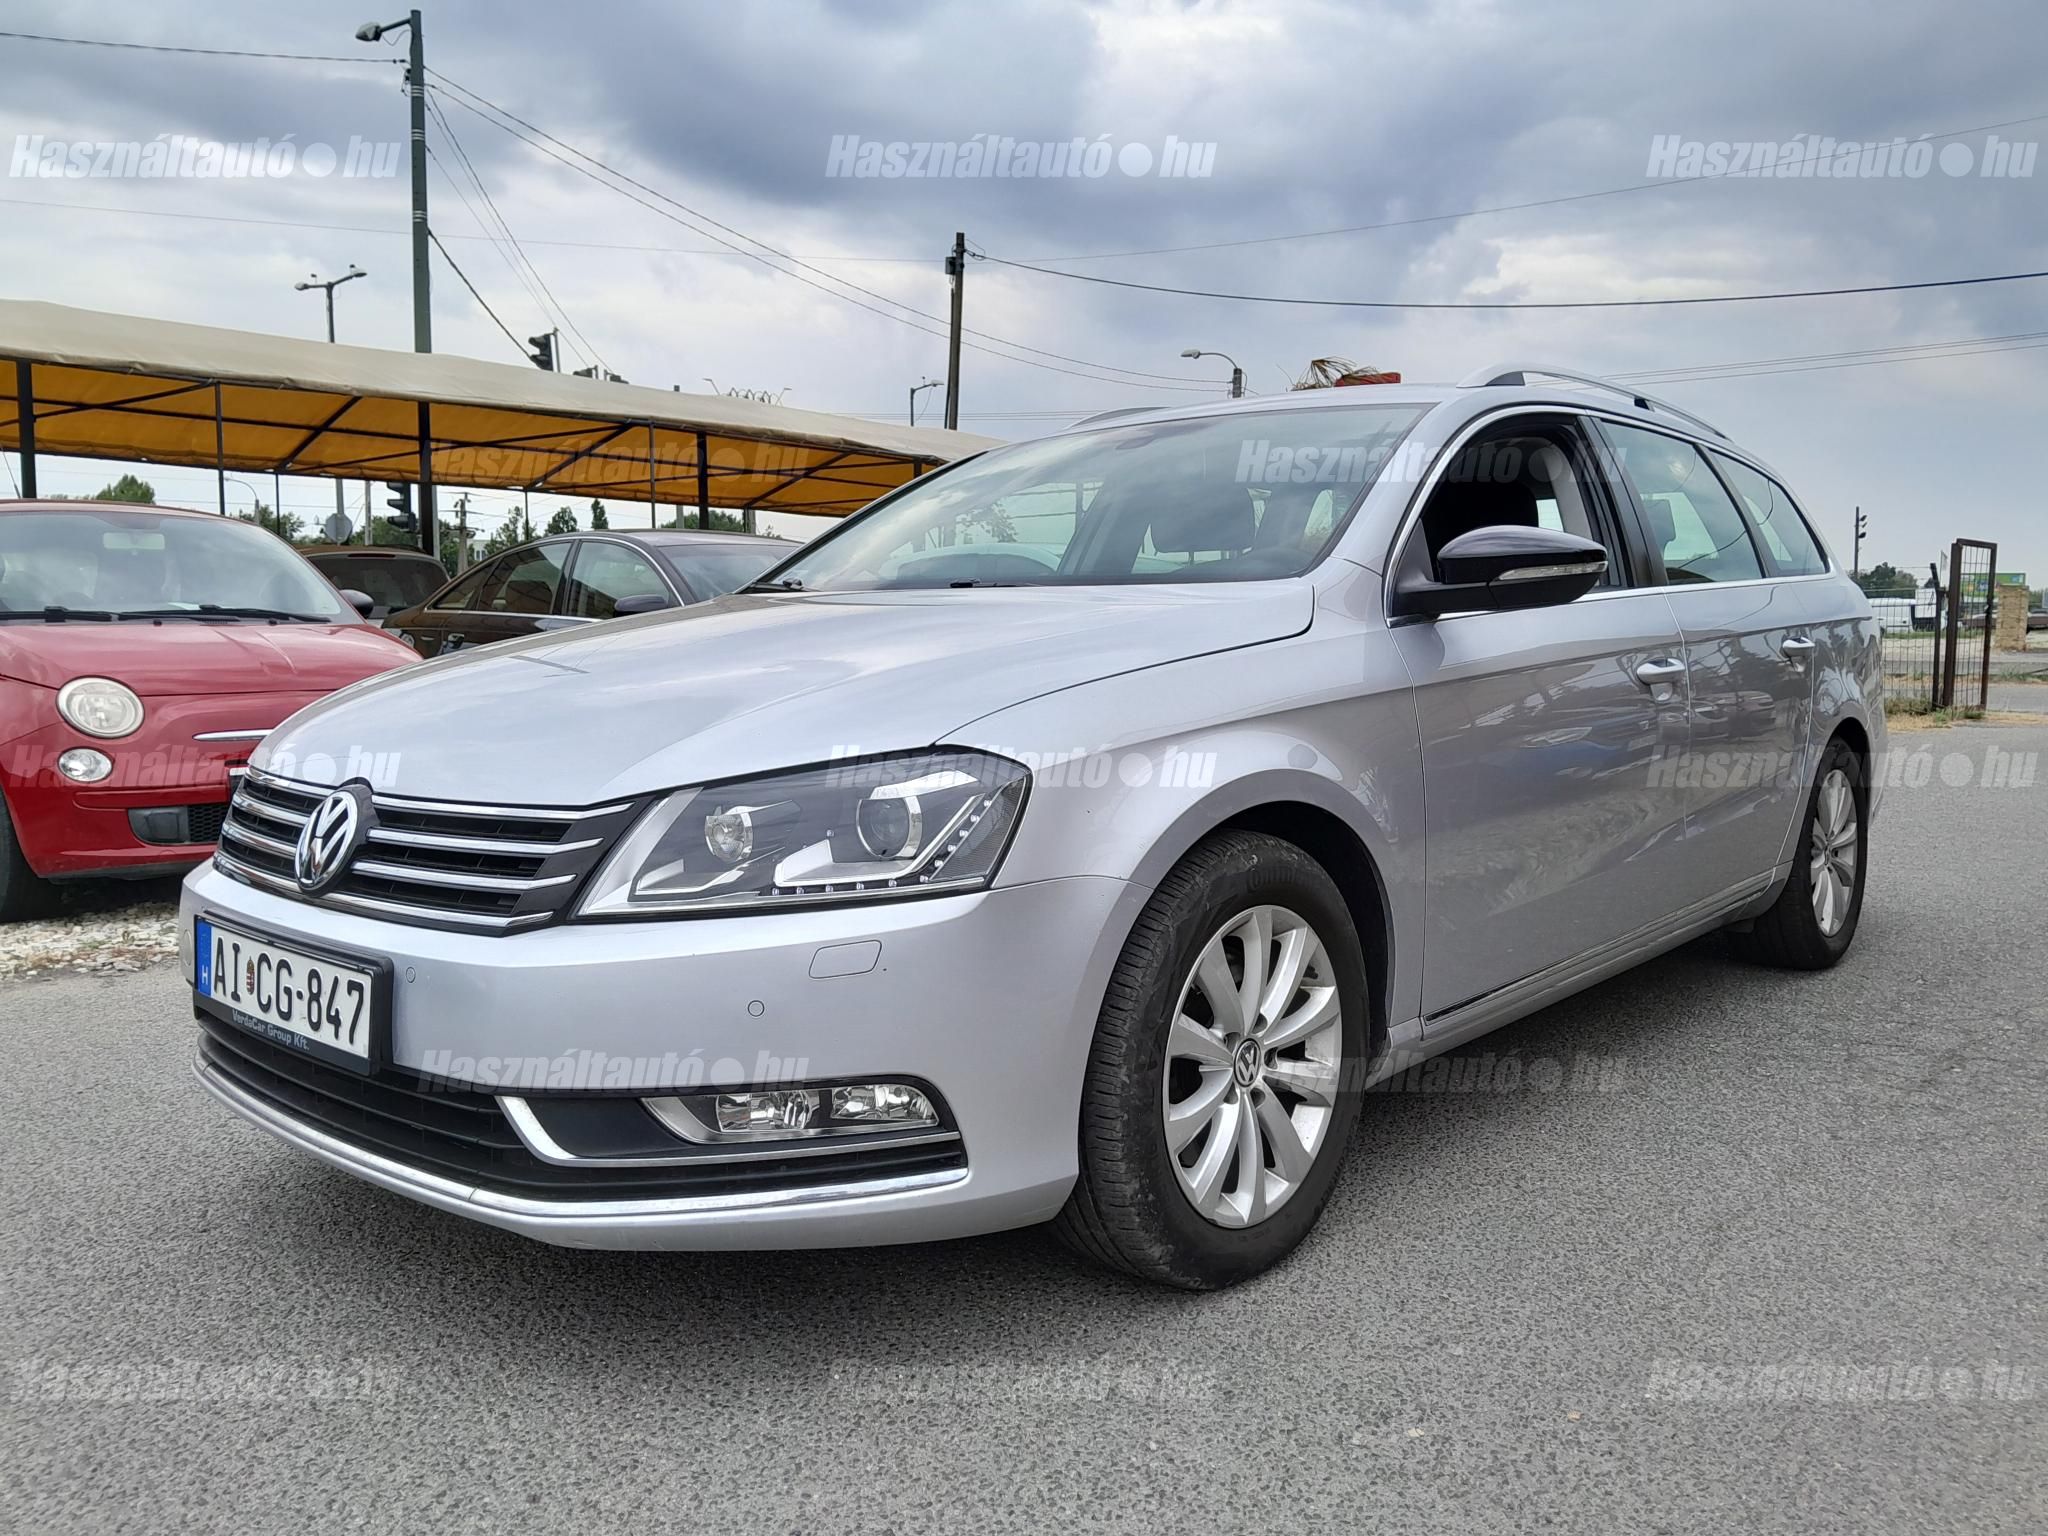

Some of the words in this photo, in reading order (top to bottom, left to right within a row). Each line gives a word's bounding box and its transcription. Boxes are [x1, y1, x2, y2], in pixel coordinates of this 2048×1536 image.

[201, 965, 209, 985] H
[214, 937, 241, 1002] AI
[257, 952, 364, 1045] CG-847
[267, 1024, 292, 1046] Group
[293, 1034, 310, 1050] Kft.
